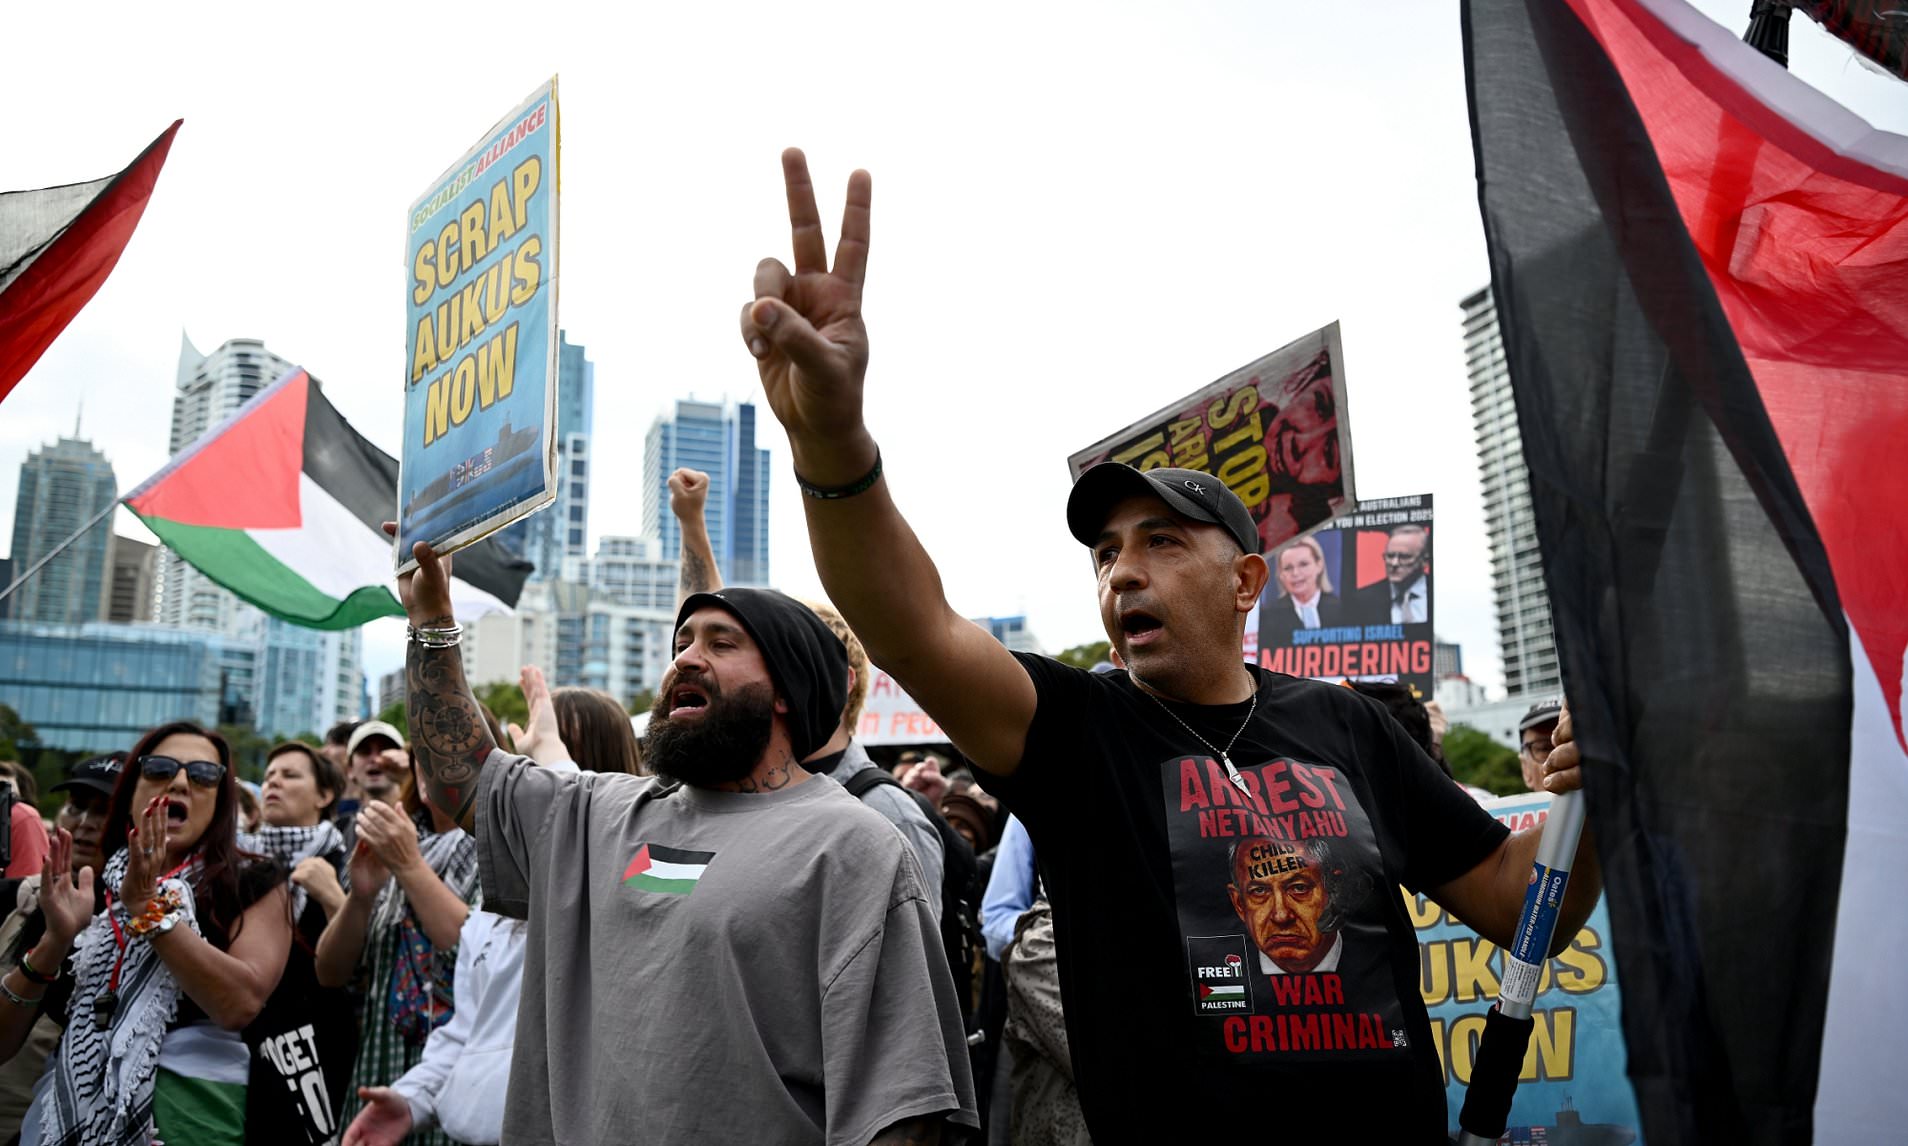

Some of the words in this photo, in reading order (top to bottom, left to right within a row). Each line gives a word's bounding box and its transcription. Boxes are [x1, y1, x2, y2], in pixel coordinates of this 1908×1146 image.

[412, 165, 475, 232] SOCIALIST
[475, 103, 546, 177] ALLIANCE
[413, 154, 542, 306] SCRAP
[411, 234, 542, 386] AUKUS
[423, 320, 519, 449] NOW
[1207, 385, 1270, 508] STOP
[1184, 480, 1206, 495] CK
[1360, 495, 1422, 512] AUSTRALIANS
[1355, 514, 1365, 526] IN
[1365, 511, 1409, 526] ELECTION
[1292, 626, 1362, 645] SUPPORTING
[1364, 624, 1404, 640] ISRAEL
[1261, 640, 1430, 679] MURDERING
[1179, 759, 1347, 815] ARREST
[1199, 808, 1348, 841] NETANYAHU
[1249, 842, 1297, 861] CHILD
[1247, 856, 1309, 881] KILLER
[1547, 876, 1562, 902] Oates
[1198, 966, 1231, 979] FREE
[1201, 1000, 1247, 1010] PALESTINE
[1271, 974, 1345, 1007] WAR
[1223, 1013, 1394, 1054] CRIMINAL
